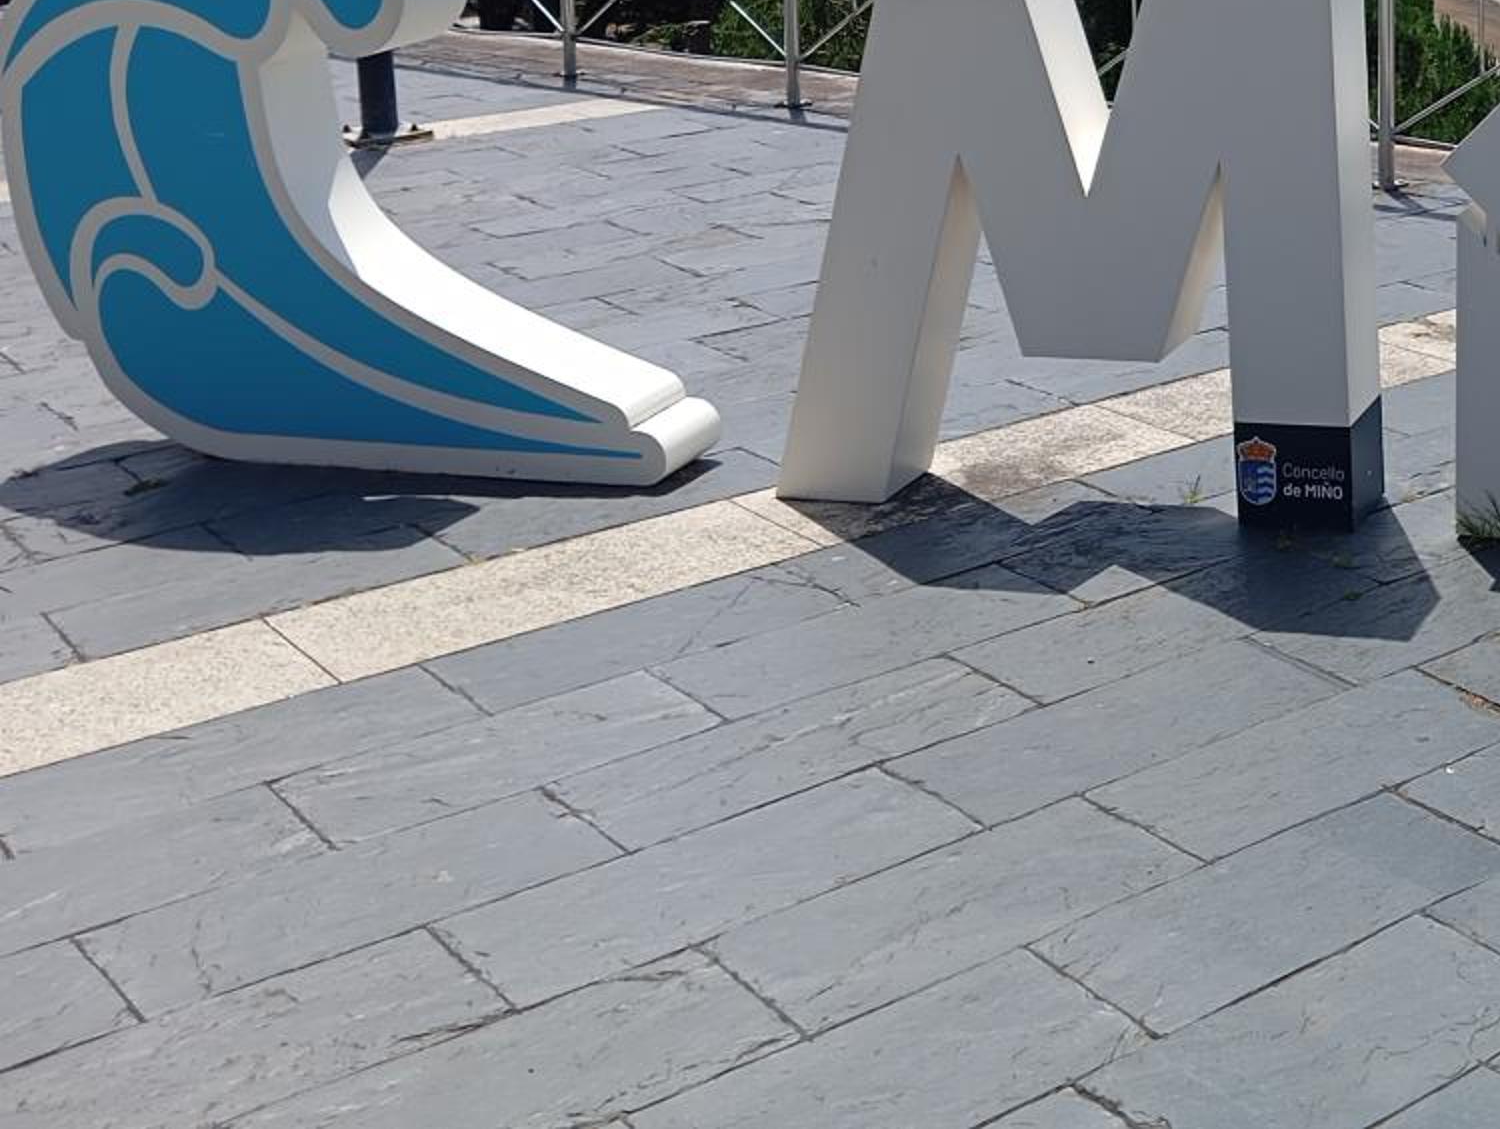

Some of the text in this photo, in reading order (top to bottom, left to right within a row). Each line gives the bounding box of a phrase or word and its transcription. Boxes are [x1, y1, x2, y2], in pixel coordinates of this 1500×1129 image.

[1282, 462, 1345, 480] Concello
[1282, 481, 1343, 499] de MIÑO
